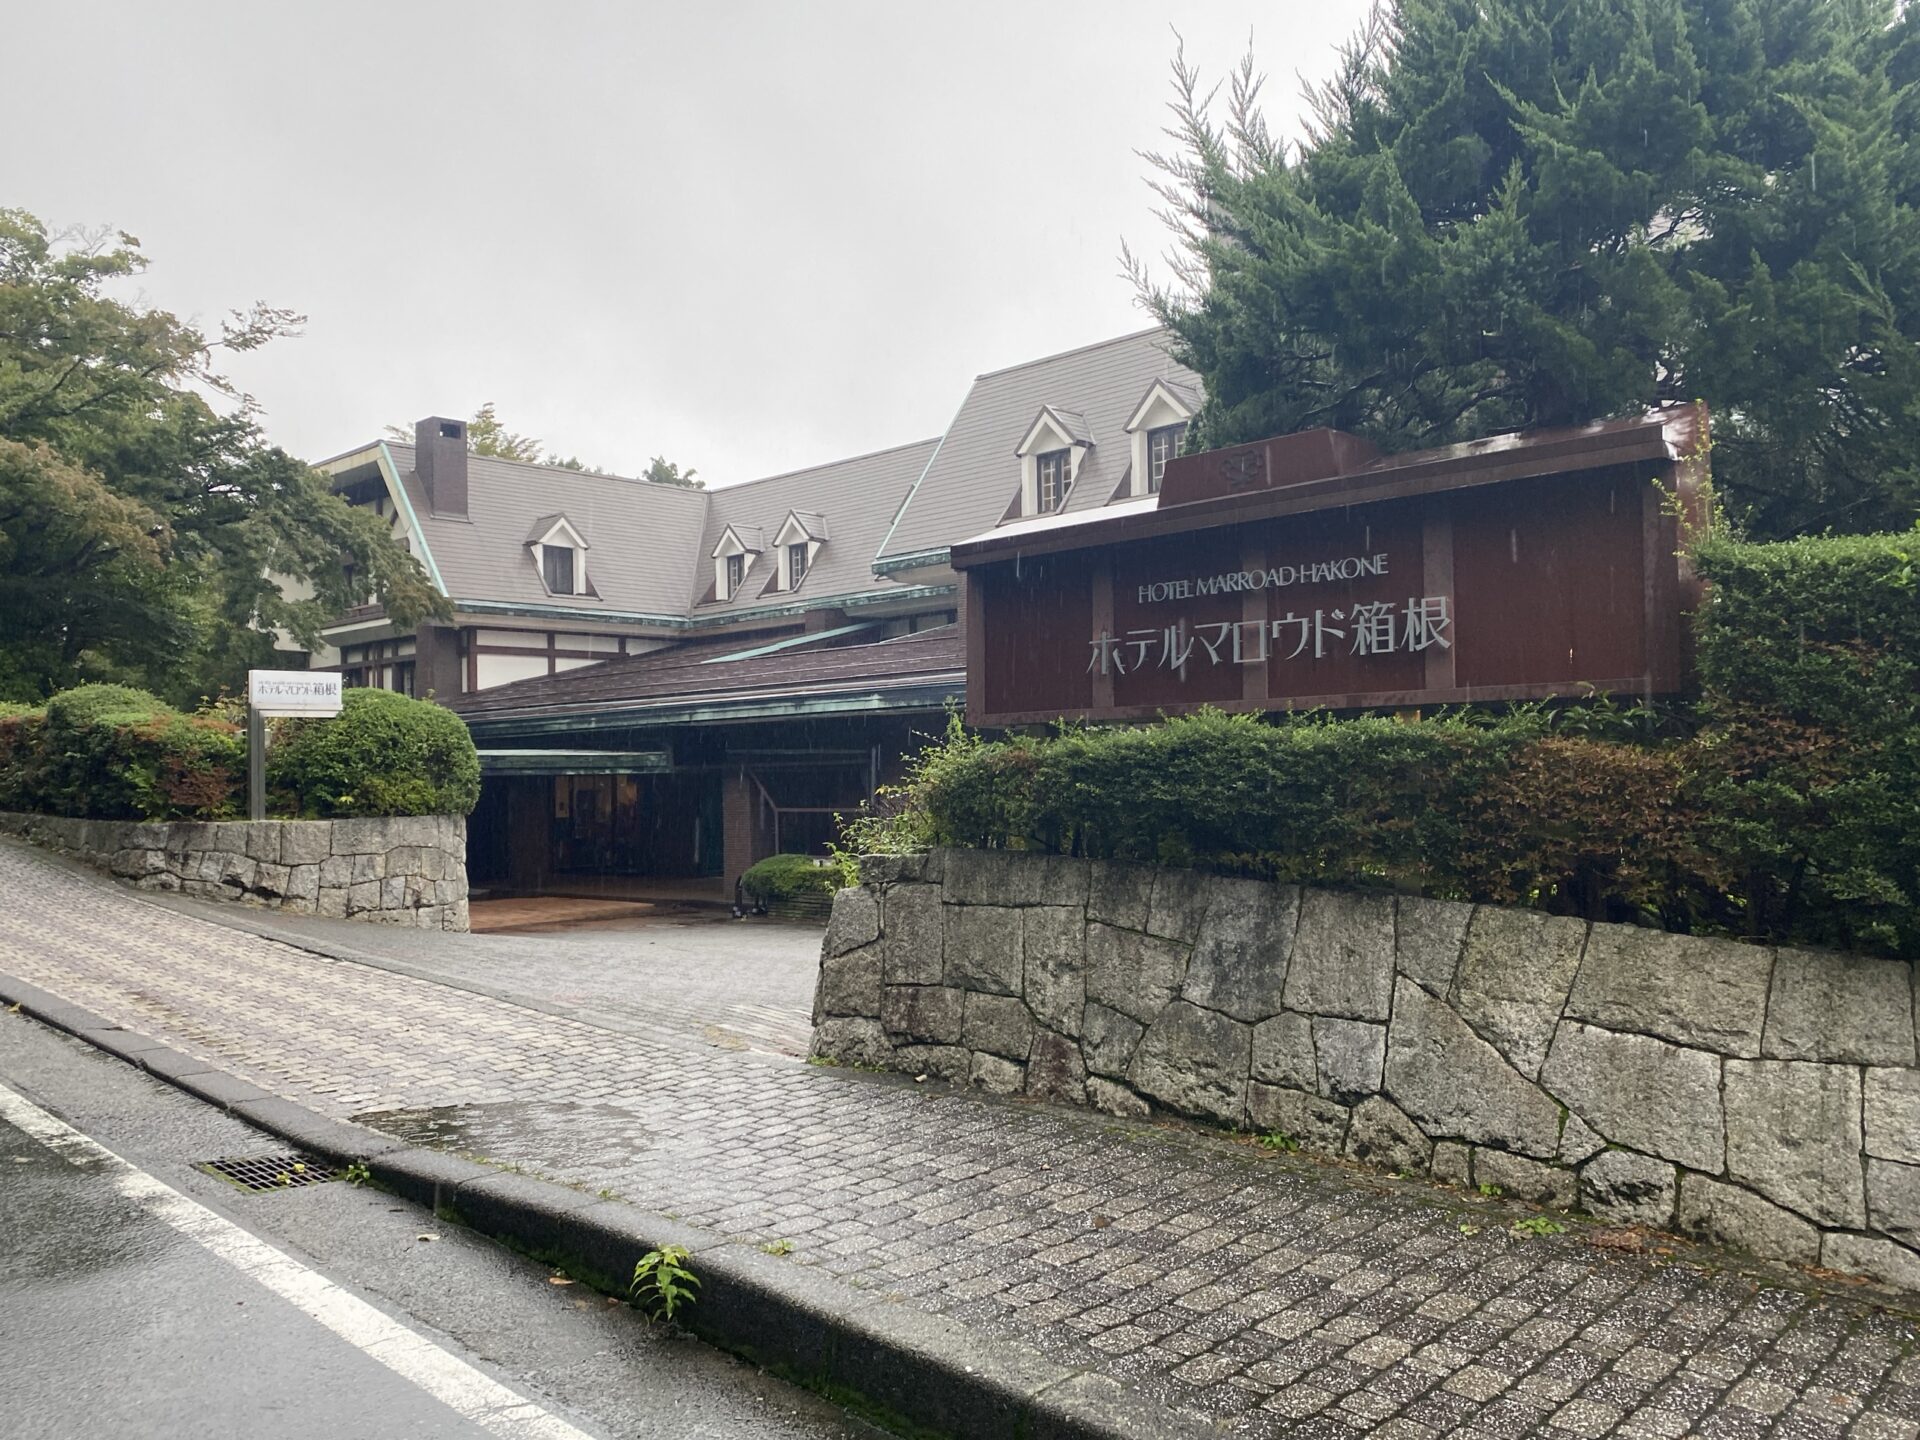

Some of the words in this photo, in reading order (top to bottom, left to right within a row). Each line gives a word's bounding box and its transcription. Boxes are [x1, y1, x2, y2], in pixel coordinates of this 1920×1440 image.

[1138, 580, 1195, 604] HOTEL
[1196, 566, 1296, 596] MARROAD
[1300, 553, 1389, 584] HAKONE
[1086, 596, 1452, 675] ホテルマロウド箱根
